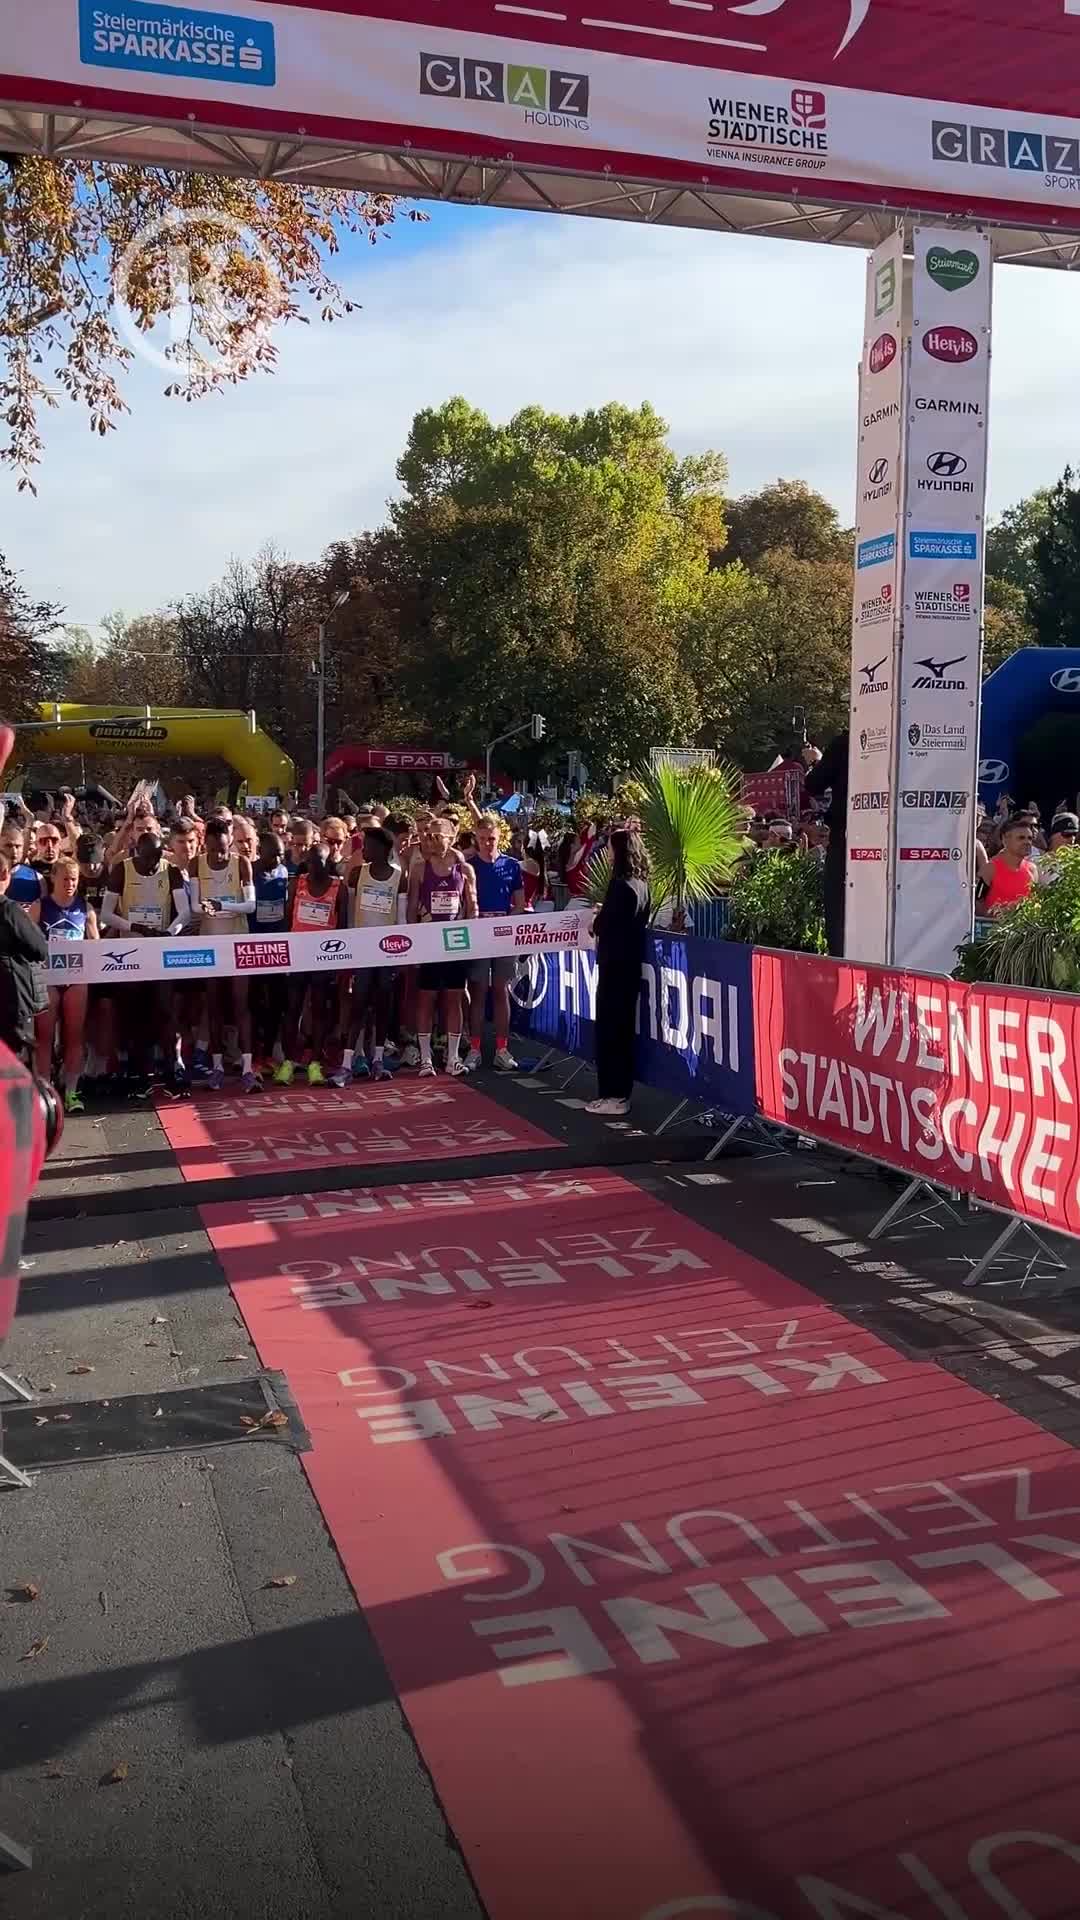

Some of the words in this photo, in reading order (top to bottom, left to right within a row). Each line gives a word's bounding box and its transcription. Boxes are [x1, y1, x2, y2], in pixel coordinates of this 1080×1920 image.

[92, 10, 236, 43] Steiermärkische
[93, 30, 236, 68] SPARKASSE
[425, 58, 581, 113] GRAZ
[524, 110, 590, 131] HOLDING
[708, 97, 790, 125] WIENER
[707, 119, 828, 150] STÄDTISCHE
[706, 148, 740, 161] VIENNA
[741, 152, 794, 167] INSURANCE
[795, 158, 827, 170] GROUP
[936, 127, 1073, 172] GRAZ
[1044, 174, 1080, 191] SPORT
[928, 333, 974, 356] Hervis
[863, 402, 899, 427] GARMIN
[917, 479, 974, 493] HYUNDAI
[914, 544, 963, 554] SPARKASSE
[914, 591, 952, 601] WIENER
[925, 724, 941, 735] Das
[943, 724, 965, 735] Land
[922, 738, 966, 748] Steiermark
[384, 755, 443, 766] SPAR
[854, 793, 888, 808] GRAZ
[903, 792, 964, 807] GRAZ
[856, 851, 881, 859] SPAR
[909, 850, 949, 859] SPAR
[514, 930, 579, 946] MARATHON
[516, 922, 547, 935] GRAZ
[237, 943, 287, 956] KLEINE
[382, 939, 410, 950] Hervis
[238, 953, 289, 967] ZEITUNG
[316, 953, 353, 962] HYUNDAI
[559, 950, 740, 1073] HYNDAI
[853, 982, 1073, 1105] WIENER
[198, 1092, 457, 1121] KLEINE
[213, 1119, 501, 1150] ZEITUNG
[778, 1048, 1072, 1206] STÄDTISCHE
[217, 1129, 516, 1164] KLEINE
[247, 1179, 598, 1223] KLEINE
[280, 1227, 678, 1283] ZEITUNG
[291, 1248, 712, 1310] KLEINE
[337, 1319, 834, 1398] ZEITUNG
[356, 1352, 889, 1445] KLEINE
[435, 1467, 1080, 1602] ZEITUNG
[471, 1534, 1080, 1687] LEINE
